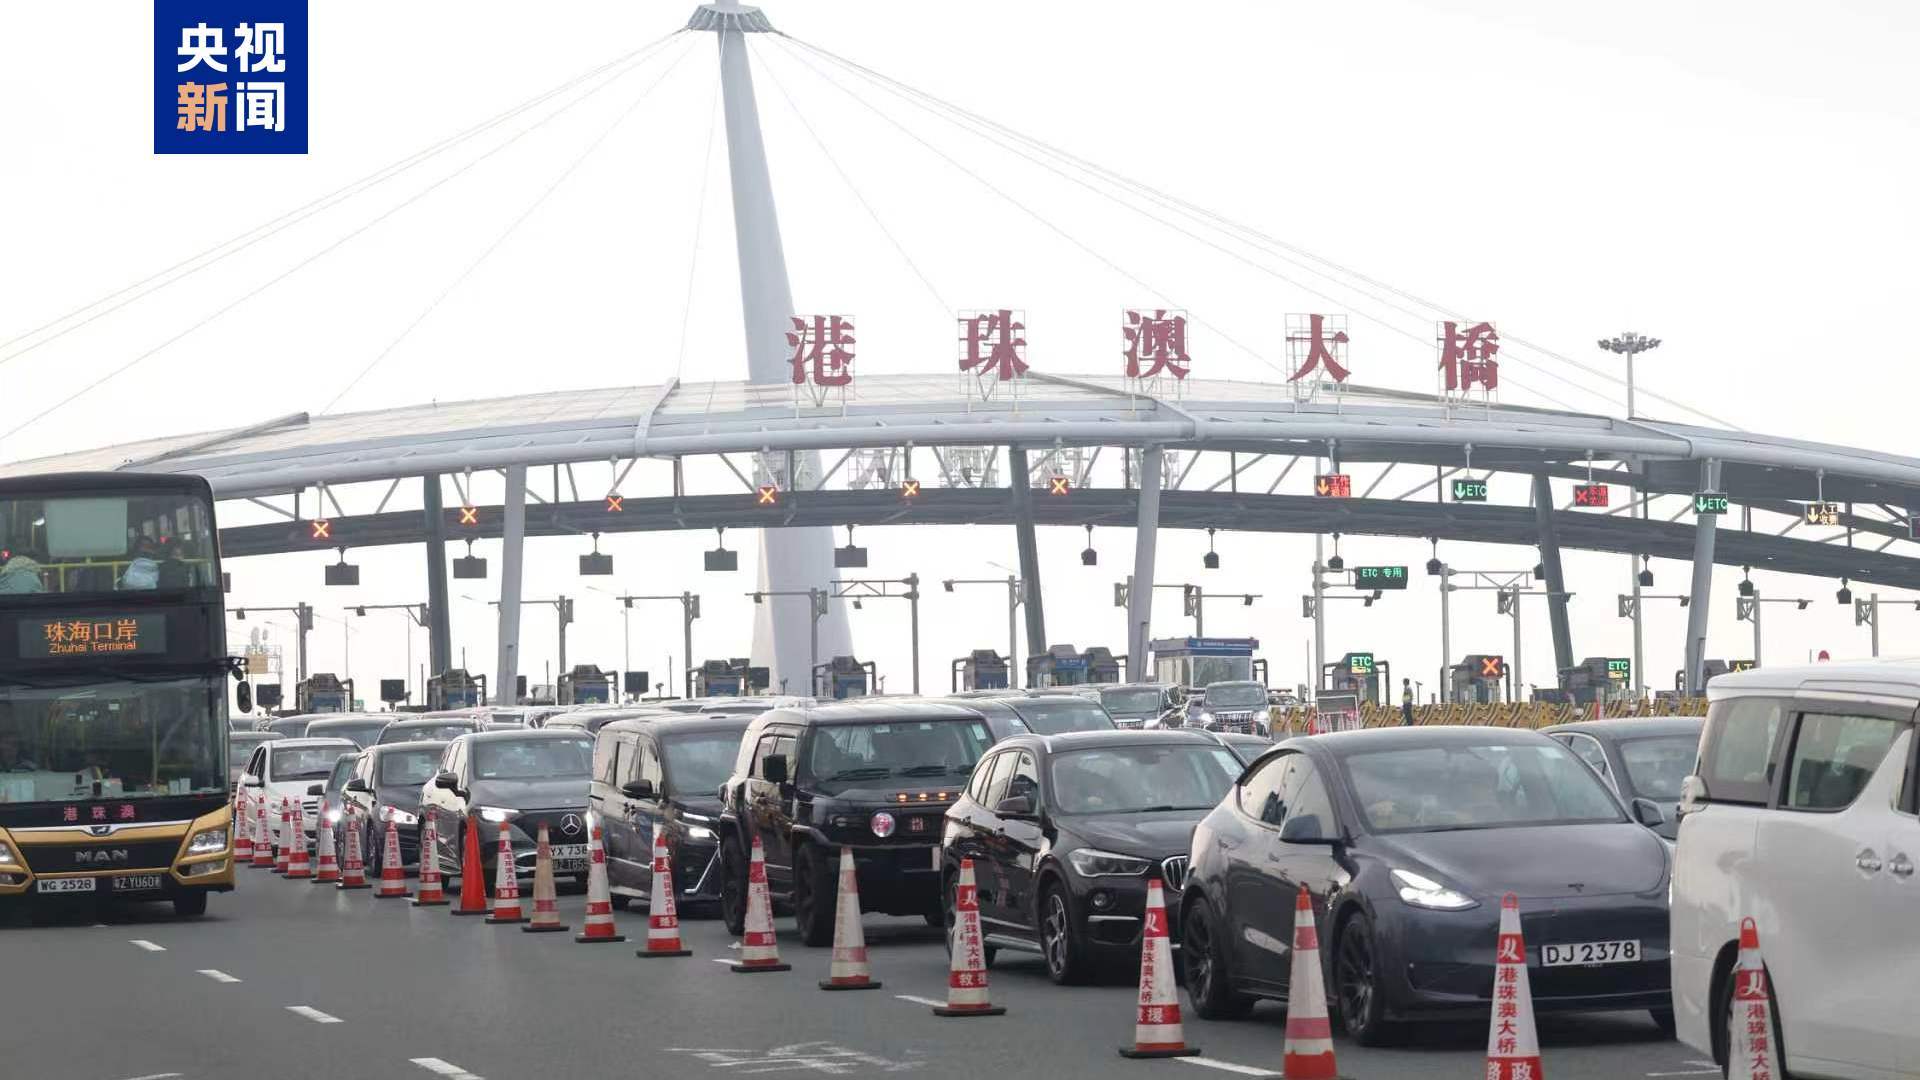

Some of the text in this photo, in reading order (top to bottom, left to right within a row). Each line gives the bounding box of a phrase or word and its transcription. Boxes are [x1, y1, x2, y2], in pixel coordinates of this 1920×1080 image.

[785, 309, 1499, 391] 港珠澳大橋
[1467, 485, 1487, 496] ETC
[1708, 497, 1727, 509] ETC
[1820, 504, 1837, 514] 人工
[1362, 567, 1402, 577] ETC 专用
[44, 620, 138, 641] 珠海口岸
[49, 640, 136, 653] Zhuhai Terminal
[1351, 656, 1371, 666] ETC
[1608, 661, 1628, 670] ETC
[75, 850, 128, 862] MAN
[40, 879, 92, 891] WG 2528
[1547, 942, 1635, 963] DJ 2378
[1497, 967, 1518, 1054] 港珠澳大桥
